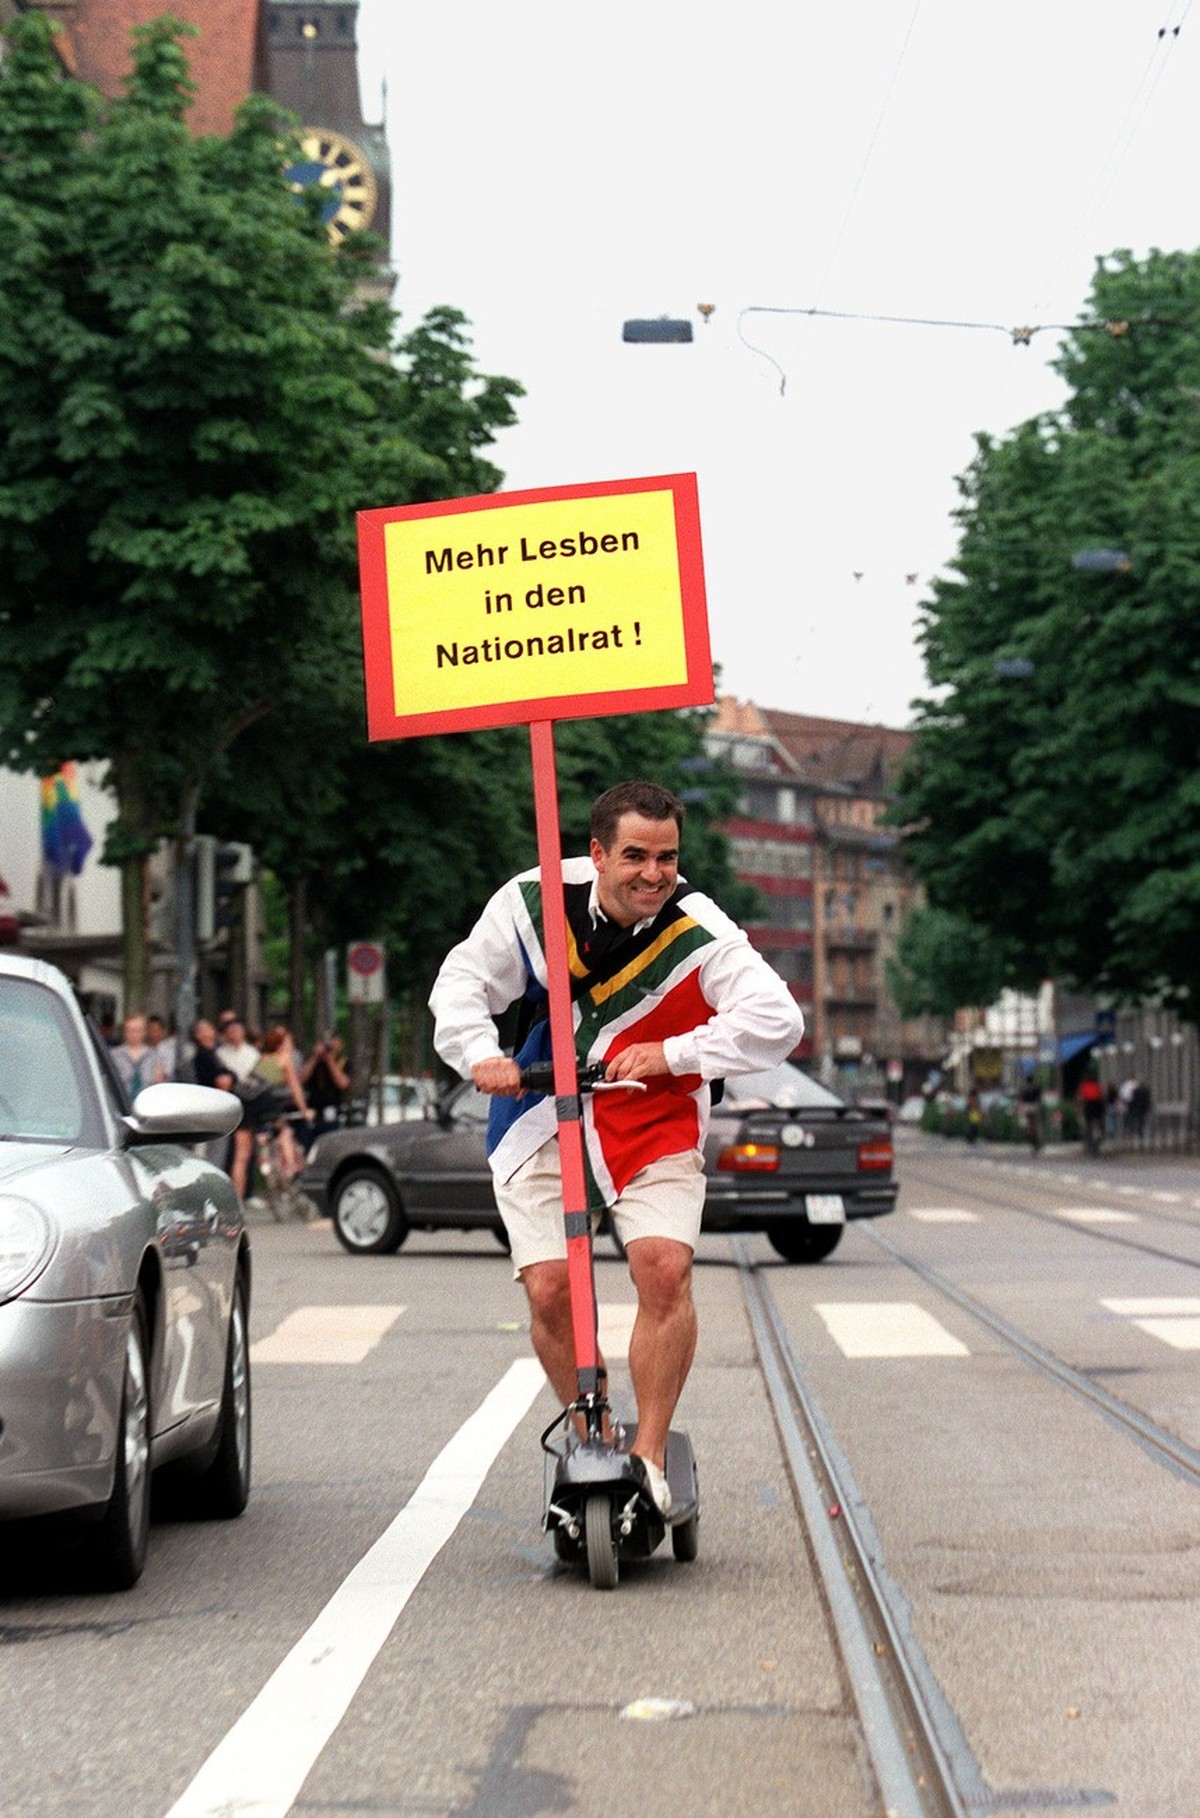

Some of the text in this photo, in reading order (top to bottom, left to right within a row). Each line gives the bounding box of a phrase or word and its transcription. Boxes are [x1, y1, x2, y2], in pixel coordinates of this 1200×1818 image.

[425, 531, 640, 574] Mehr Lesben
[484, 584, 586, 614] in den
